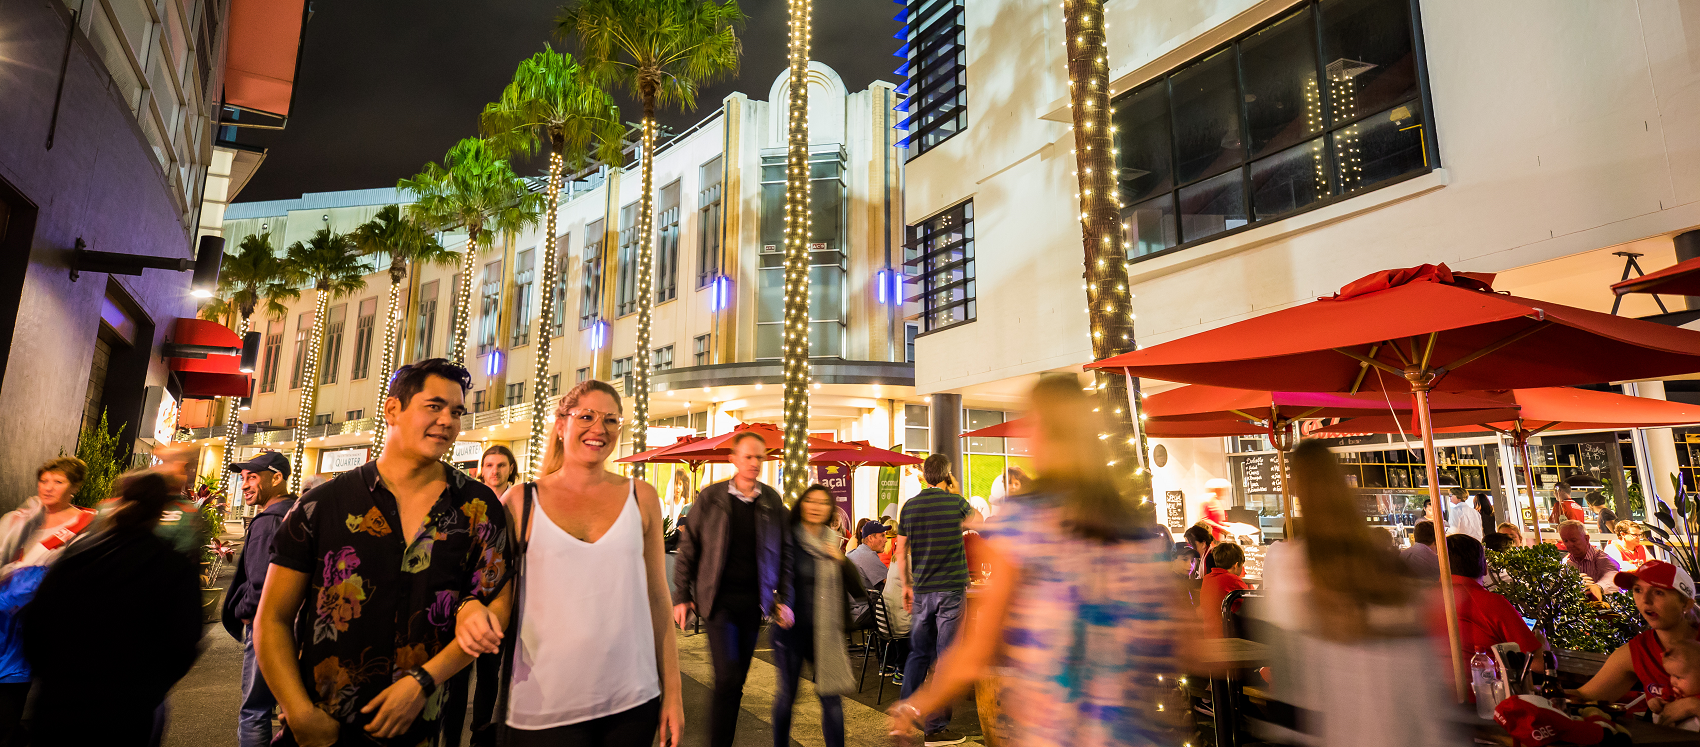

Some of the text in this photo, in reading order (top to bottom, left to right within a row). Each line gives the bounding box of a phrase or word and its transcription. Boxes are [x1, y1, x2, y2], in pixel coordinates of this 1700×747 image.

[1585, 443, 1606, 456] Shakes
[335, 457, 361, 467] QUARTER
[821, 474, 846, 490] açaí
[1531, 725, 1556, 741] QBE
